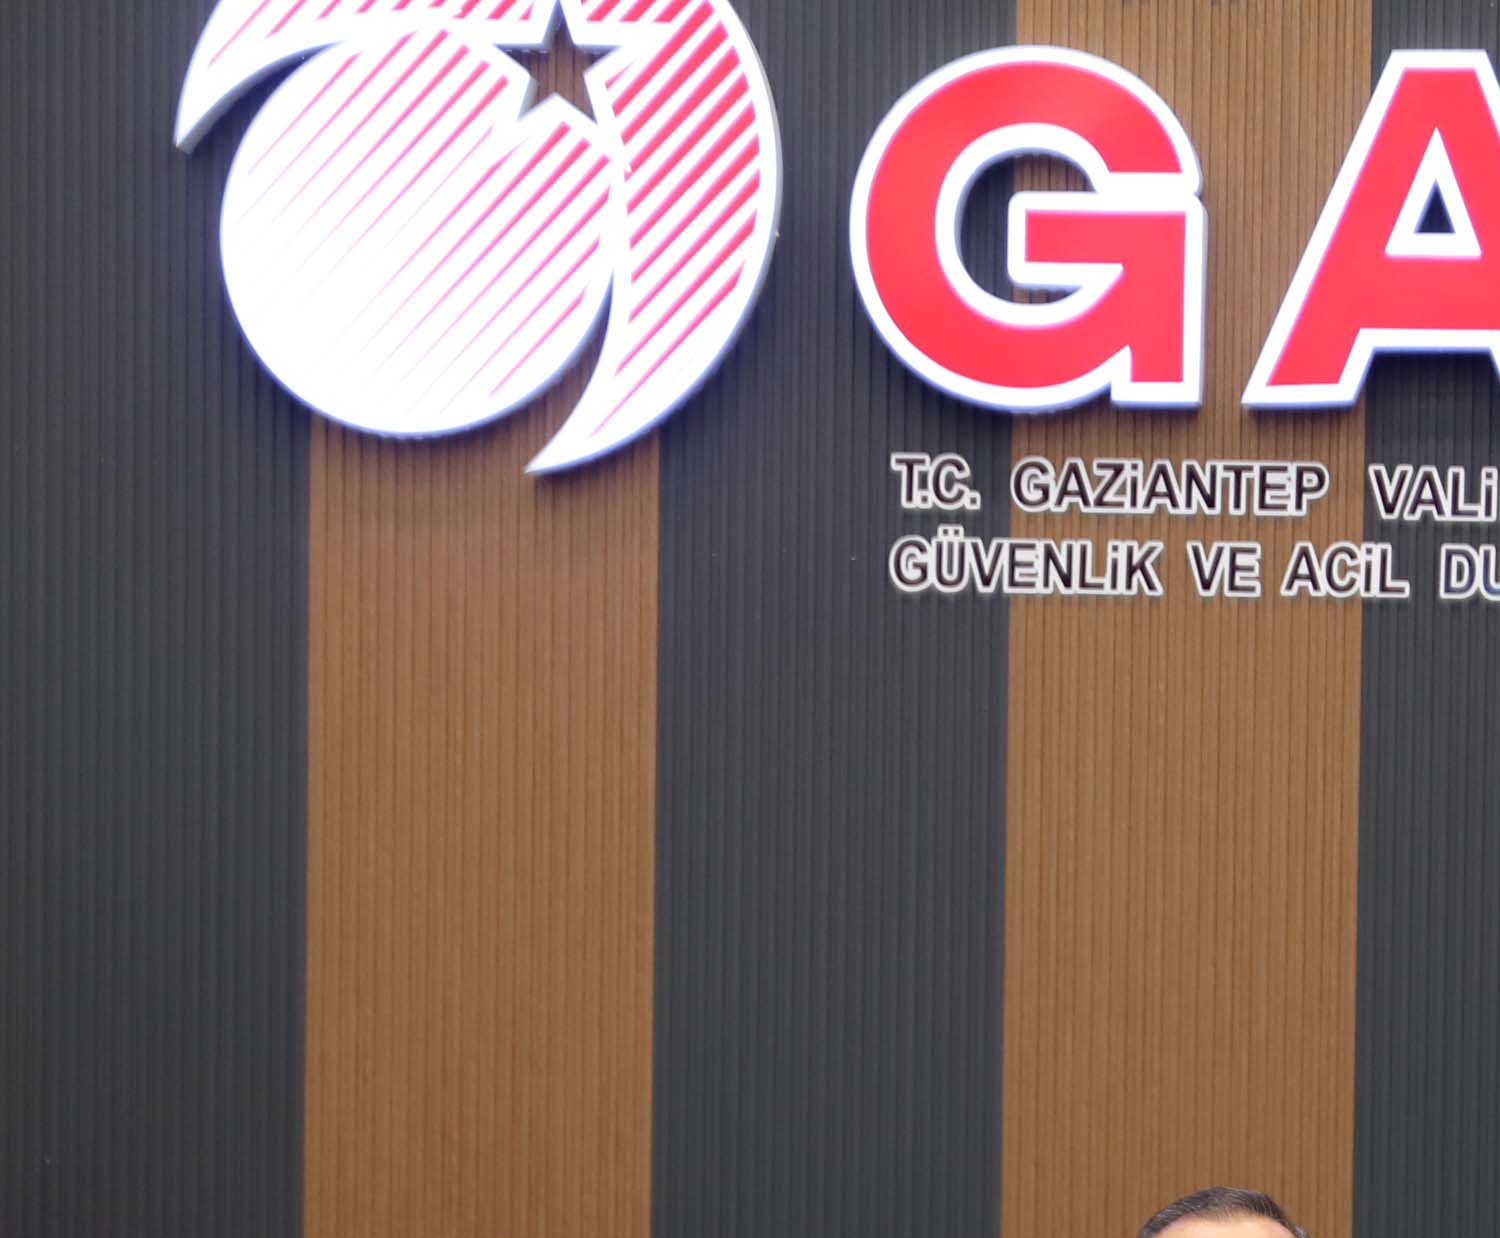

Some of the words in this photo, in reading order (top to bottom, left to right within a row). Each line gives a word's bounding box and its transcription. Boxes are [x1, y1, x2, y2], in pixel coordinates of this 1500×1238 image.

[891, 452, 982, 510] T.C.
[1010, 456, 1329, 516] GAZİANTEP
[889, 524, 1164, 594] GÜVENLİK
[1187, 541, 1262, 598] VE
[1280, 542, 1410, 599] ACİL
